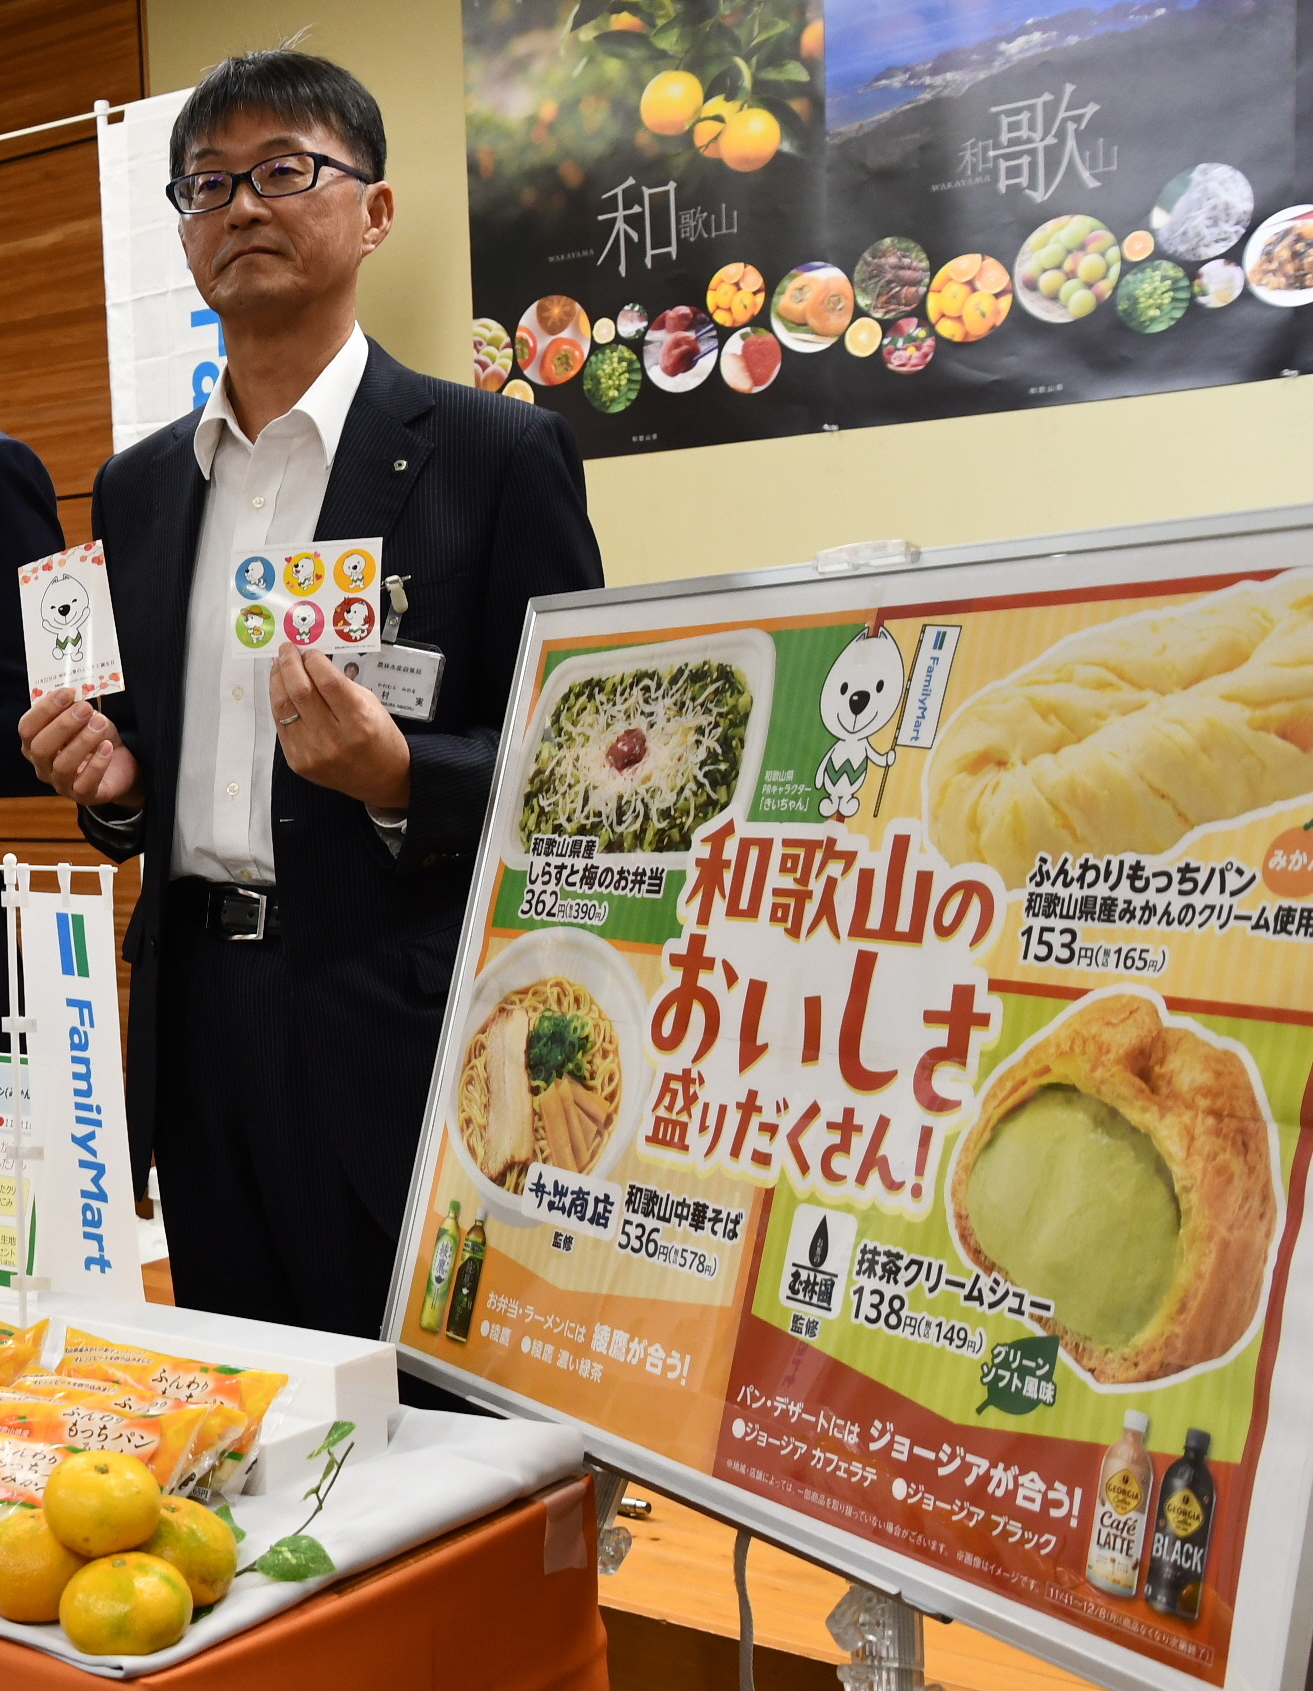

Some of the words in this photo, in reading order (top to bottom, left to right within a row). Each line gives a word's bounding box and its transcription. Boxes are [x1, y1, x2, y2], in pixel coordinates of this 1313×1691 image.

[956, 82, 1118, 203] 和歌山
[597, 176, 737, 278] 和歌山
[548, 248, 595, 263] WAKAYAMA
[909, 656, 940, 742] FamilyMart
[762, 784, 812, 795] PRキャラクター
[765, 770, 794, 781] 和歌山県
[759, 797, 810, 812] 「きいちゃん」
[532, 837, 597, 859] 和歌山県産
[528, 861, 665, 894] しらすと梅のお弁当
[685, 817, 995, 949] 和歌山の
[1029, 856, 1257, 898] ふんわりもっちパン
[1025, 891, 1313, 938] 和歌山県産みかんのクリーム使用
[651, 933, 991, 1113] おいしさ
[65, 997, 113, 1274] FamilyMart
[644, 1067, 934, 1199] 盛りだくさん!
[528, 1170, 615, 1229] 井出商店
[625, 1184, 744, 1240] 和歌山中華そば
[552, 1231, 574, 1251] 監修
[855, 1243, 1052, 1316] 抹茶クリームシュー
[486, 1291, 586, 1343] お弁当・ラーメンには
[790, 1313, 819, 1338] 監修
[556, 1349, 604, 1383] 濃い緑茶
[993, 1345, 1050, 1377] グリーン
[152, 1368, 209, 1392] ふんわり
[982, 1363, 1056, 1404] ソフト風味
[63, 1407, 125, 1425] ふんわり
[68, 1420, 156, 1450] もっちパン
[736, 1384, 861, 1445] パン・デザートには
[869, 1418, 1083, 1529] ジョージアが合う!
[745, 1420, 808, 1461] ジョージア
[810, 1447, 878, 1488] カフェラテ
[907, 1482, 985, 1528] ジョージア
[991, 1514, 1057, 1556] ブラック
[1107, 1484, 1140, 1501] GEORGIA
[1100, 1511, 1138, 1536] Café
[1167, 1504, 1201, 1522] GEORGIA
[1097, 1528, 1135, 1557] LATTE
[1152, 1532, 1204, 1573] BLACK
